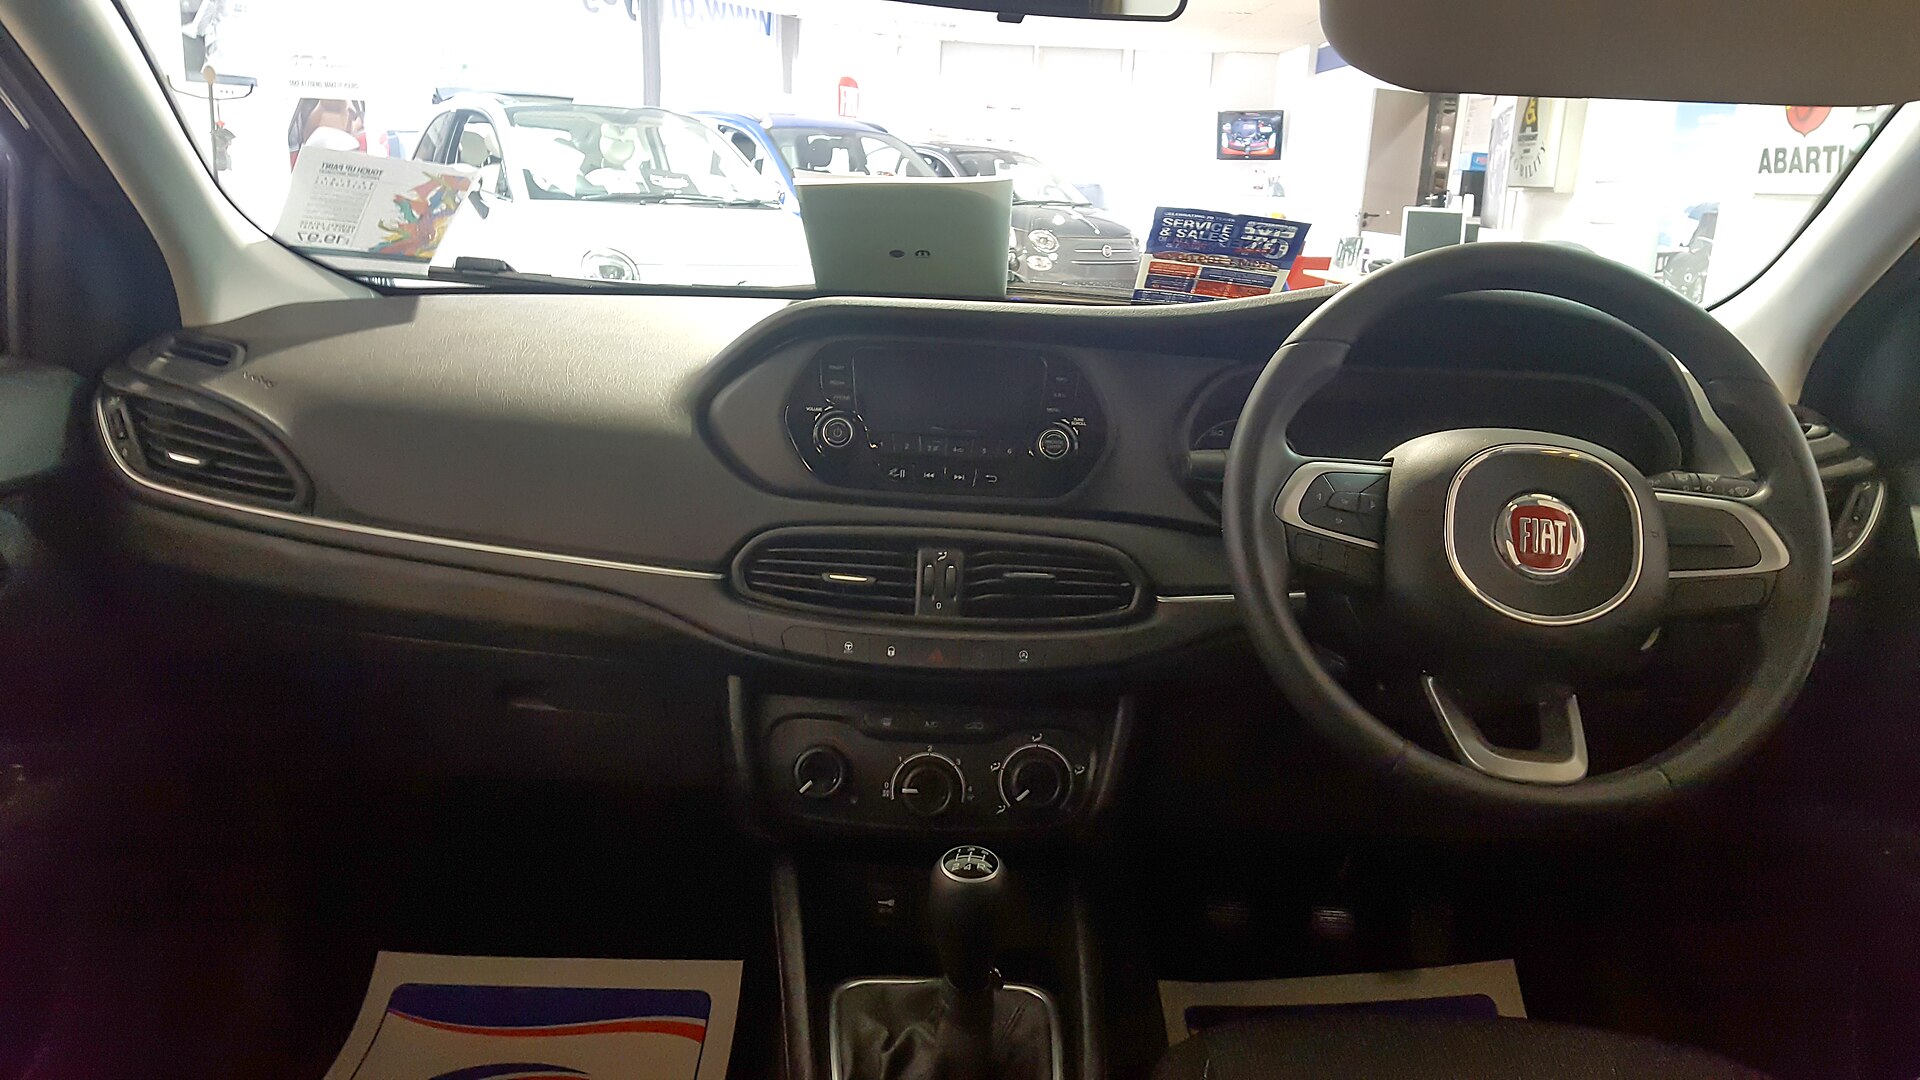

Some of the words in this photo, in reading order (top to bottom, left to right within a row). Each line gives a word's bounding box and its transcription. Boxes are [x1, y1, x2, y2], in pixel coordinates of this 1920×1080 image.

[1162, 217, 1234, 234] SERVICE
[1159, 227, 1171, 236] &
[1176, 228, 1231, 243] SALES
[1519, 516, 1567, 555] FIAT
